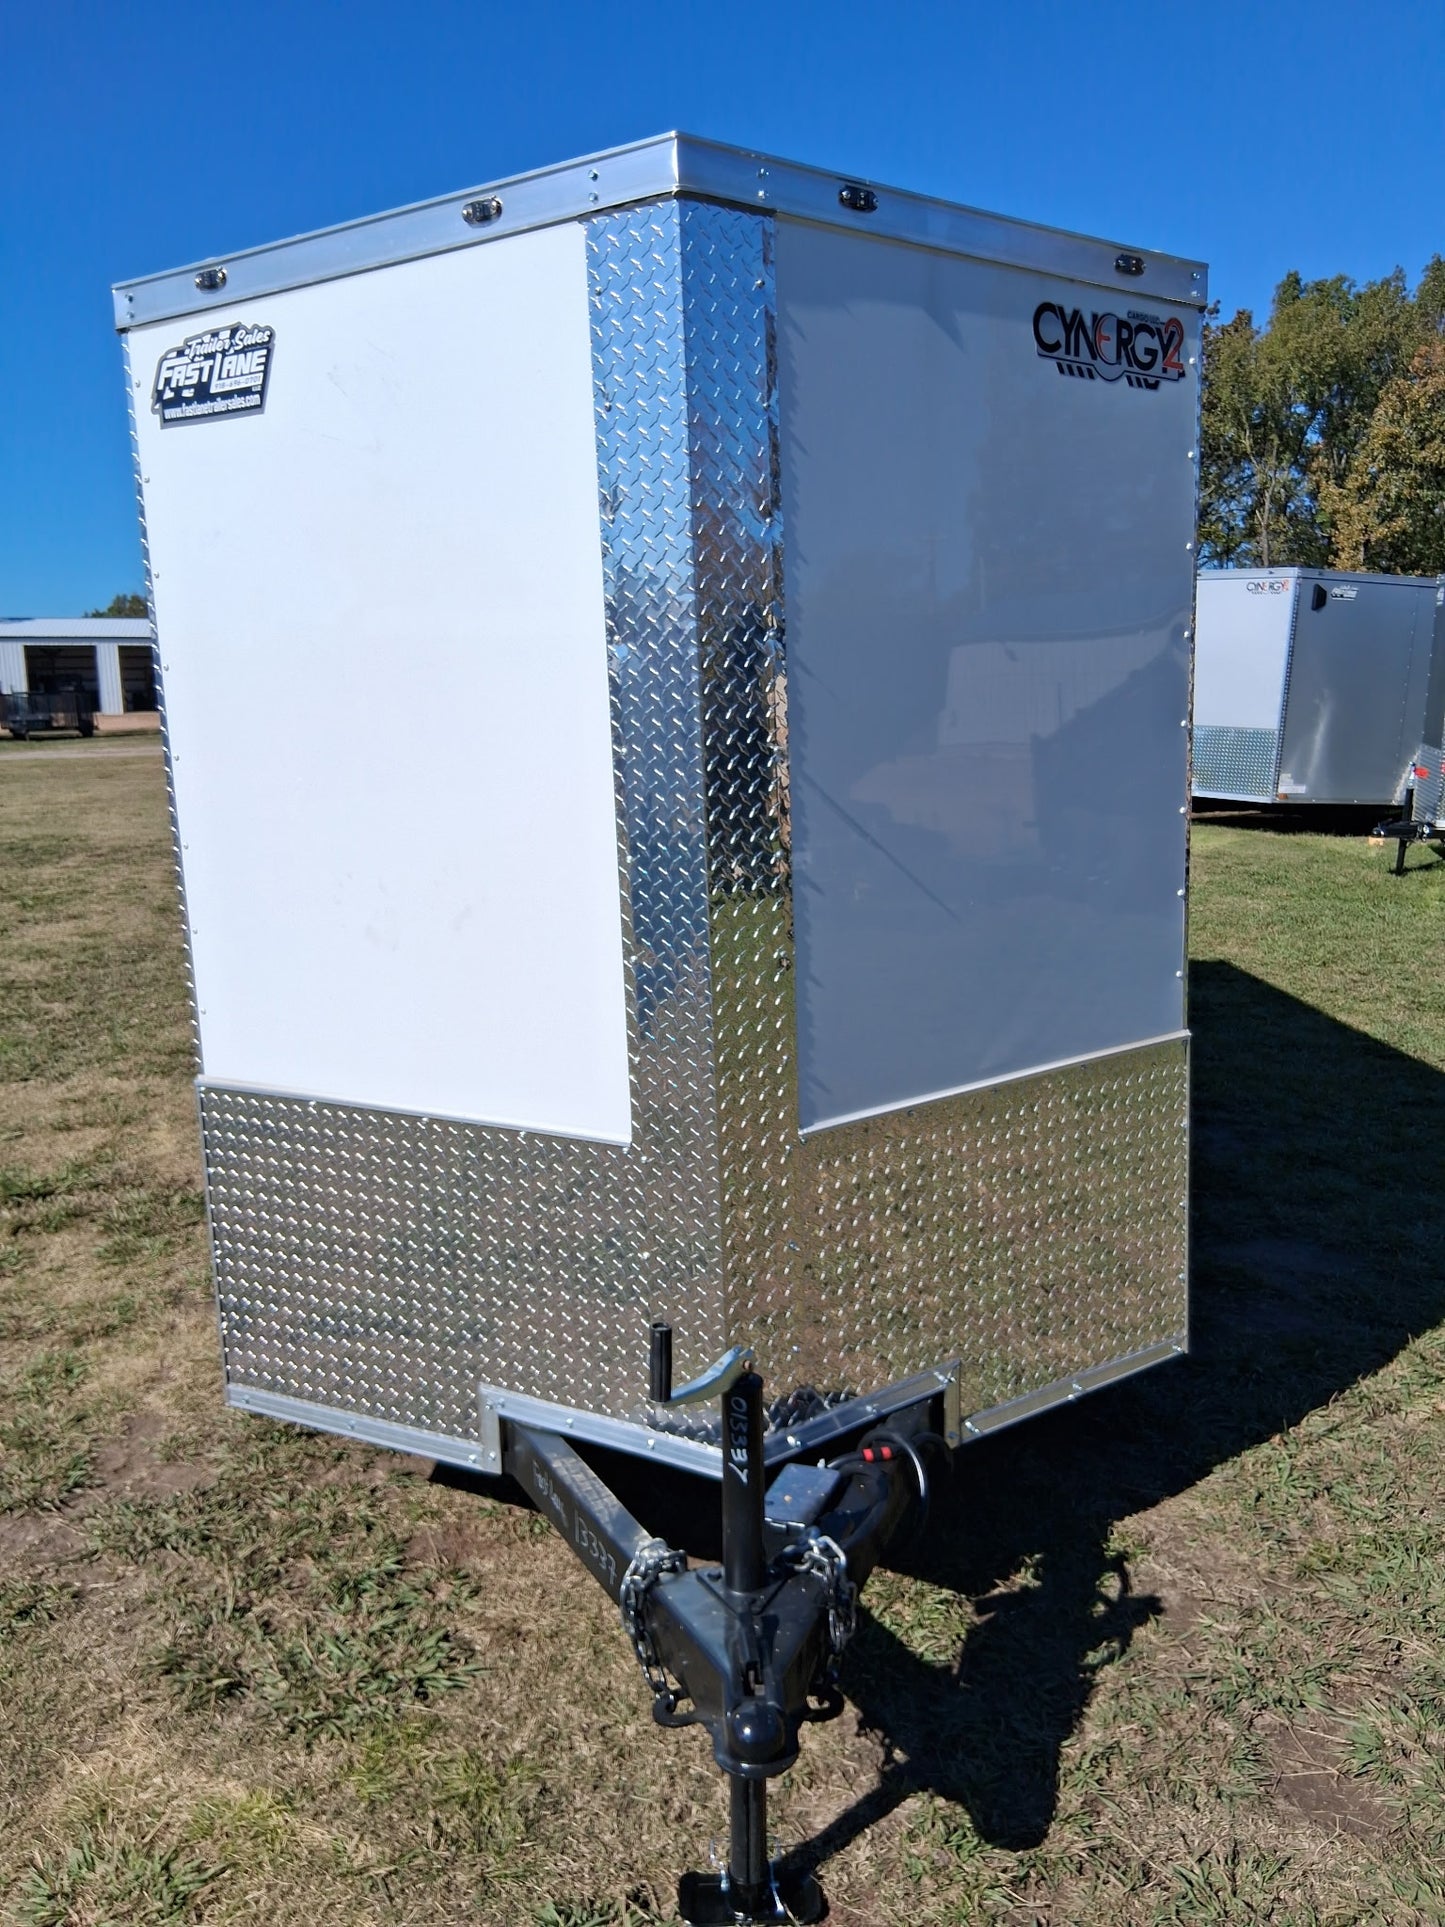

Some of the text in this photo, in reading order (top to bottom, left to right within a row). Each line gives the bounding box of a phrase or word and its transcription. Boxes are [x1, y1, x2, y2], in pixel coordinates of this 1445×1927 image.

[185, 329, 271, 360] Trailer Sales
[728, 1395, 749, 1486] 013337
[574, 1508, 618, 1585] 13337
